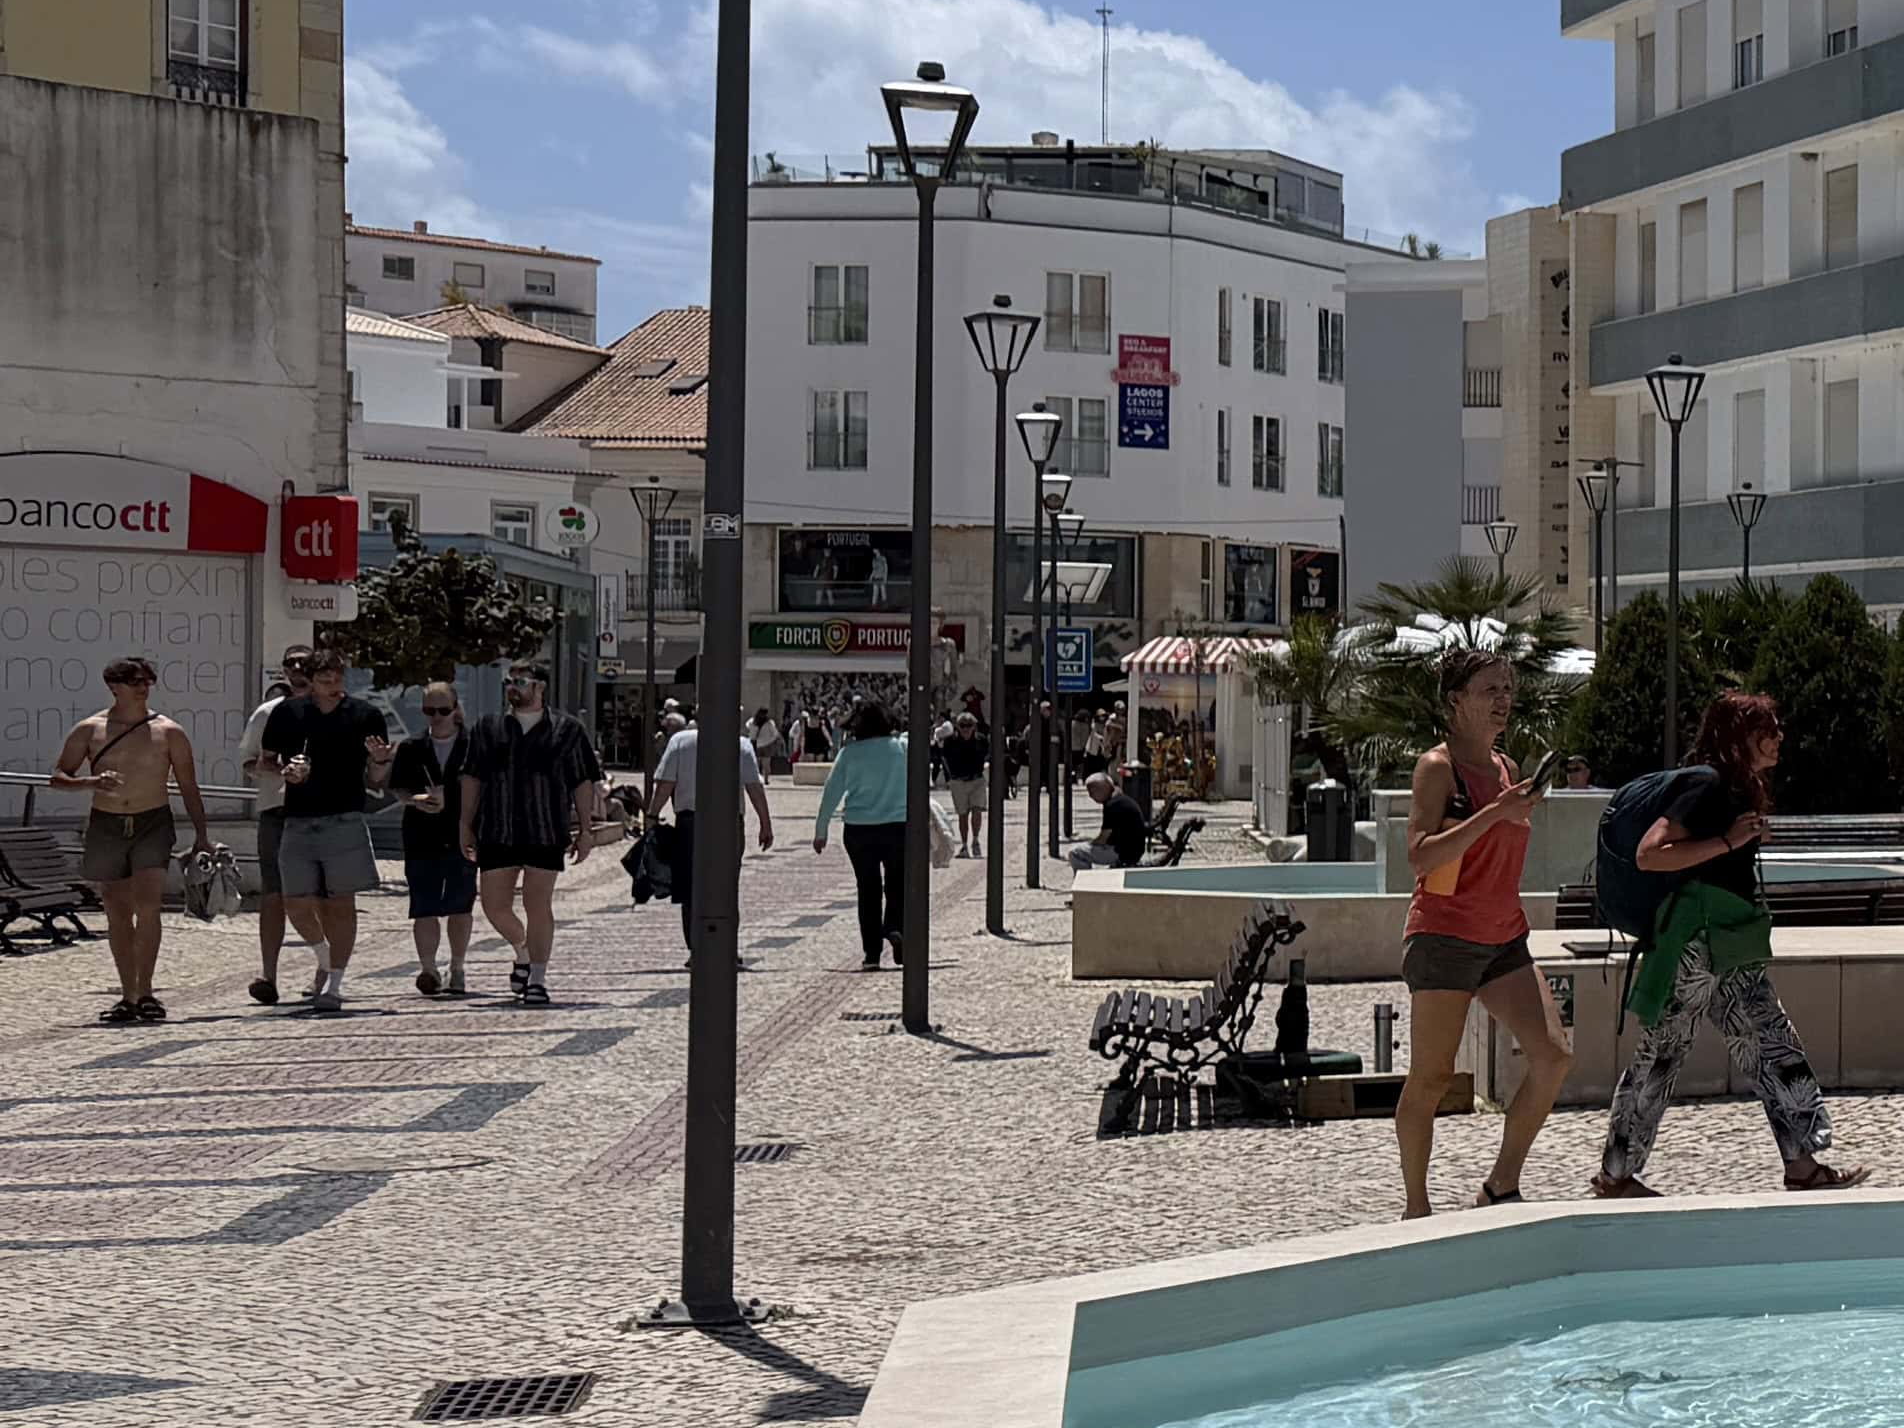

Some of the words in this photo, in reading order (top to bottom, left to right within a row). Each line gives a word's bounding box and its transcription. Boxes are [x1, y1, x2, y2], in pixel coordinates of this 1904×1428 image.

[1126, 387, 1164, 398] LAGOS
[1126, 397, 1164, 408] CENTER
[294, 519, 334, 558] ctt
[827, 532, 871, 547] PORTUGAL
[0, 548, 79, 593] les
[290, 595, 335, 611] bancoctt
[776, 627, 821, 646] FORÇA
[858, 628, 911, 646] PORTUG
